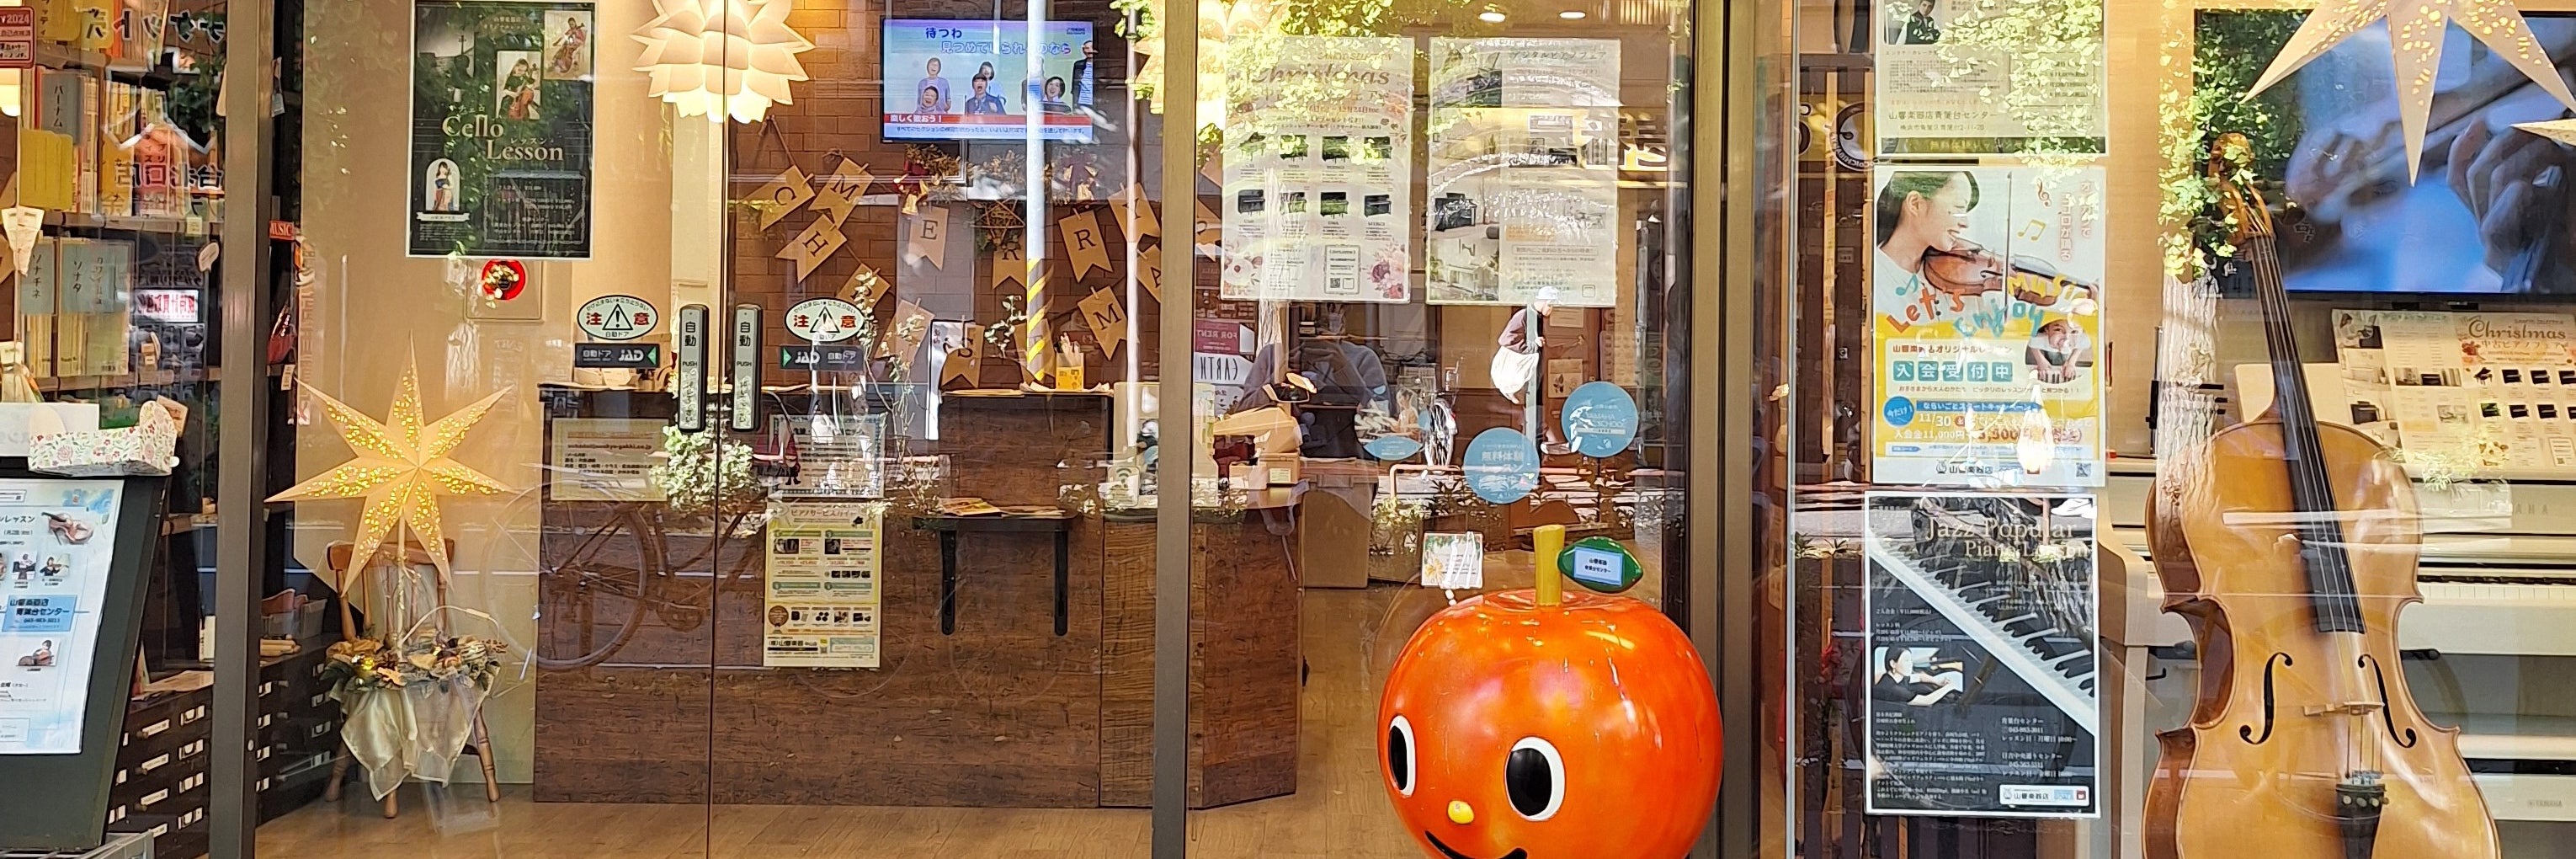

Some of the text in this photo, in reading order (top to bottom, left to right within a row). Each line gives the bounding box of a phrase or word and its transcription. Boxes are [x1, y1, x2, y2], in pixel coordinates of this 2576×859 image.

[925, 27, 962, 39] 待つわ
[941, 41, 1072, 55] 見つめてられのなら
[442, 114, 504, 137] Cello
[486, 140, 564, 162] Lesson
[32, 253, 42, 299] ソナチネ
[73, 260, 82, 294] ソナタ
[684, 321, 696, 347] 自動
[739, 321, 751, 347] 自動
[2468, 319, 2566, 339] Christmas
